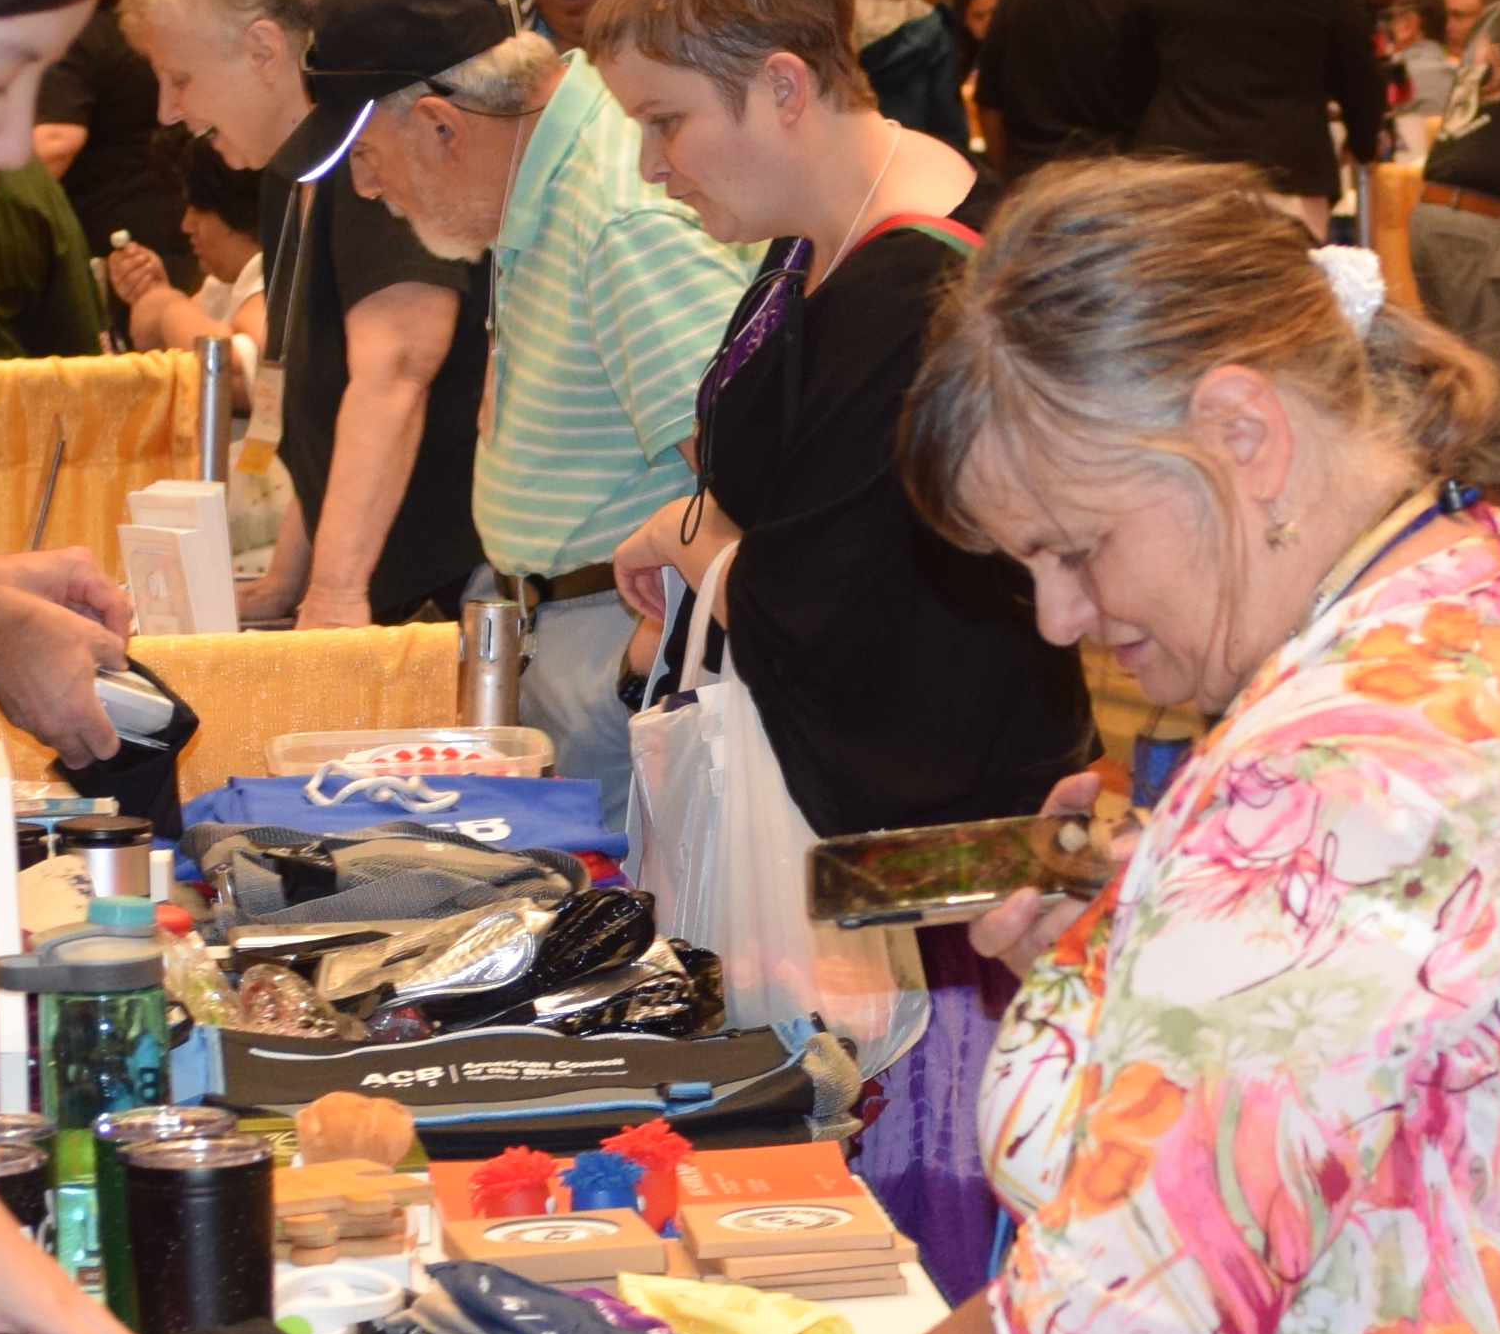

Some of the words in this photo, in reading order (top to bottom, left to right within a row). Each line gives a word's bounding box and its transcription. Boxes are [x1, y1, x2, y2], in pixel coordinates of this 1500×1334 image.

[360, 1066, 445, 1086] ACB
[461, 1059, 552, 1070] American
[554, 1057, 626, 1069] Council
